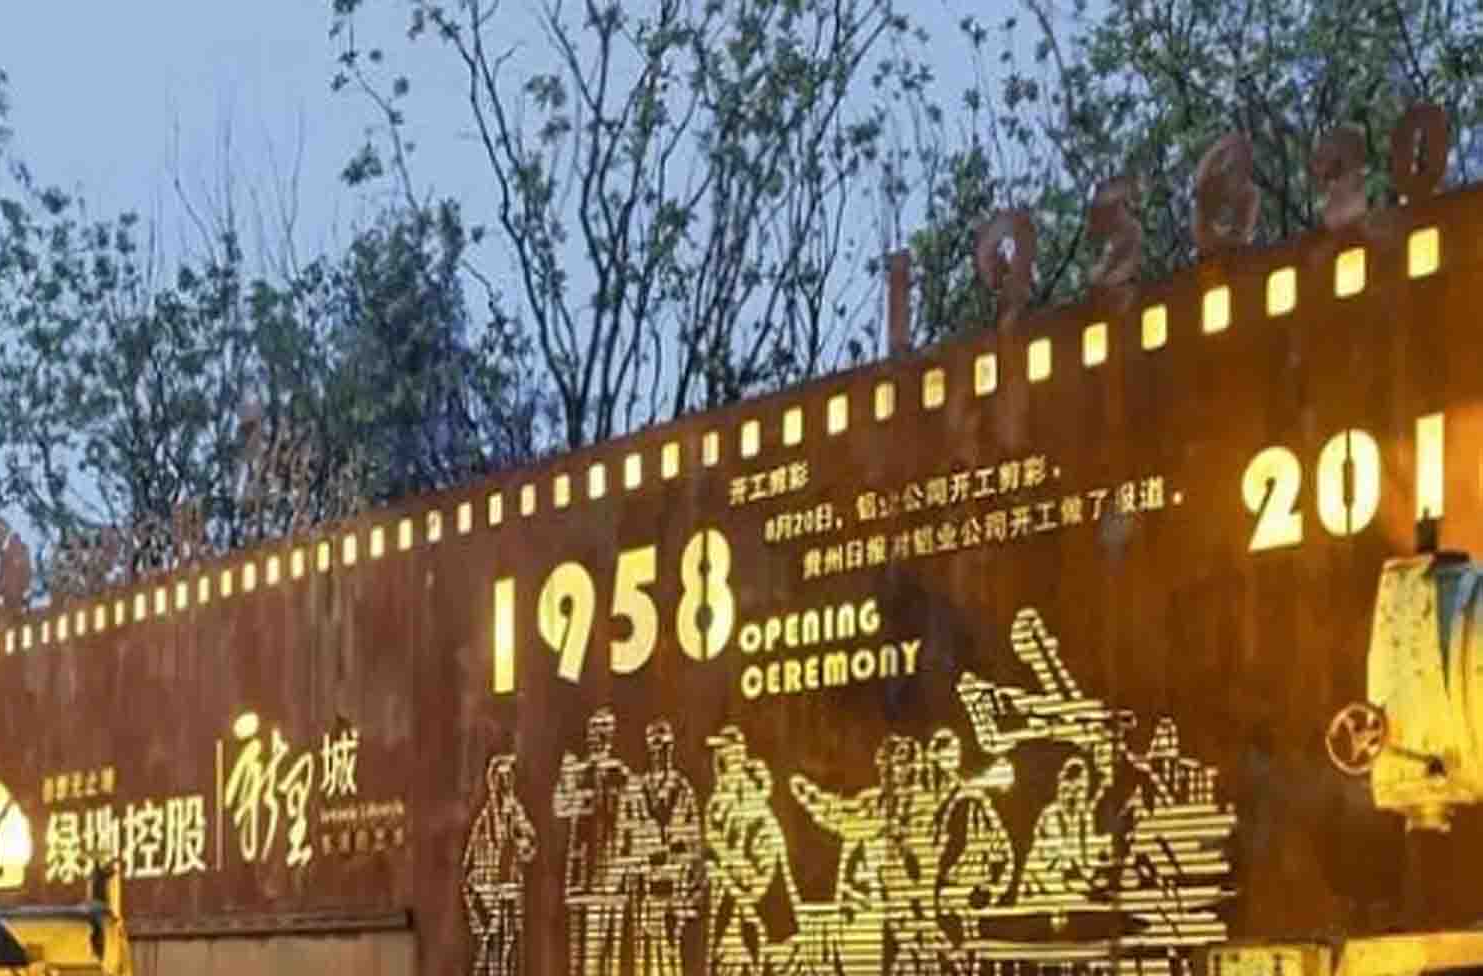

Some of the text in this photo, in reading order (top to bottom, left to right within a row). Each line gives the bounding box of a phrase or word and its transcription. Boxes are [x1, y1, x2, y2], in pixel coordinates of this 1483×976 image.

[492, 528, 737, 696] 1958
[739, 600, 882, 653] OPENING
[740, 640, 922, 699] CEREMONY
[45, 795, 207, 885] 绿地控股
